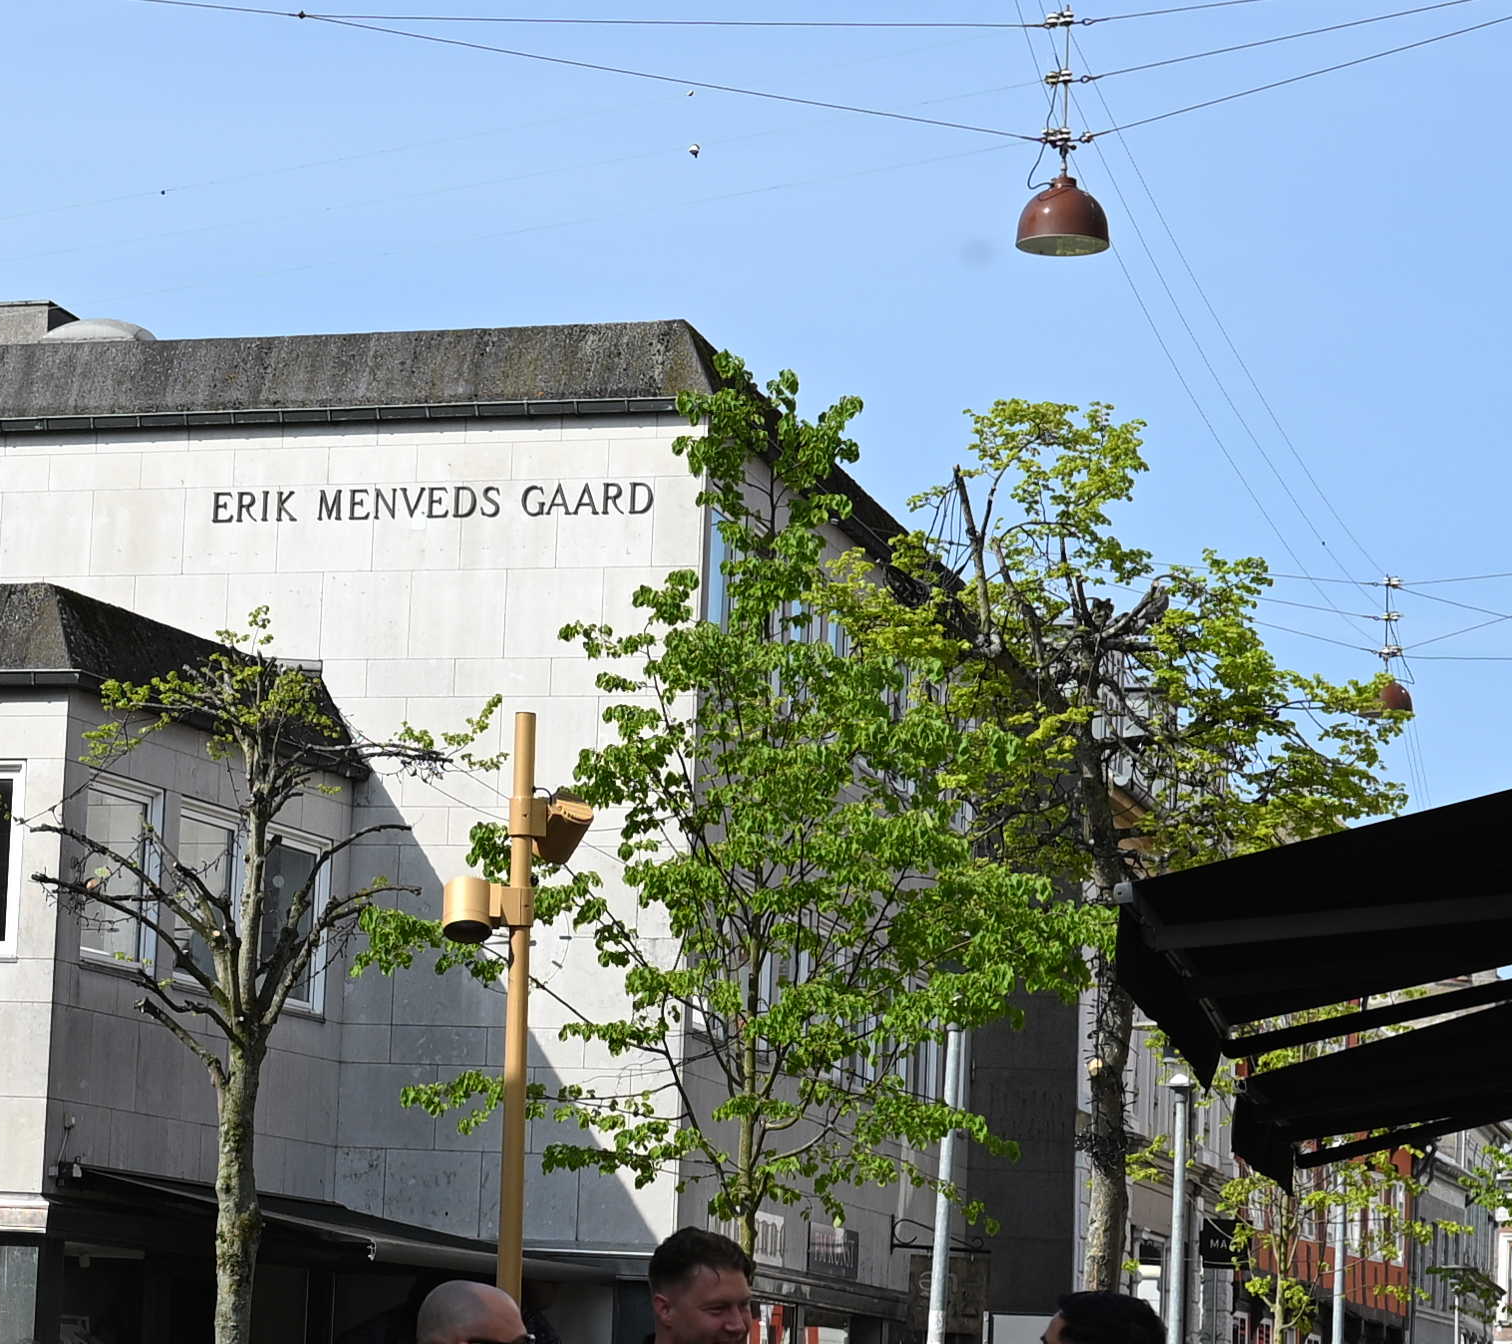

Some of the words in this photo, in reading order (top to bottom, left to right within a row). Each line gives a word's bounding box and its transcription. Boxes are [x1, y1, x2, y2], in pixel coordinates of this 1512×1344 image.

[212, 490, 297, 523] ERIK
[317, 485, 500, 521] MENVEDS
[521, 481, 655, 516] GAARD
